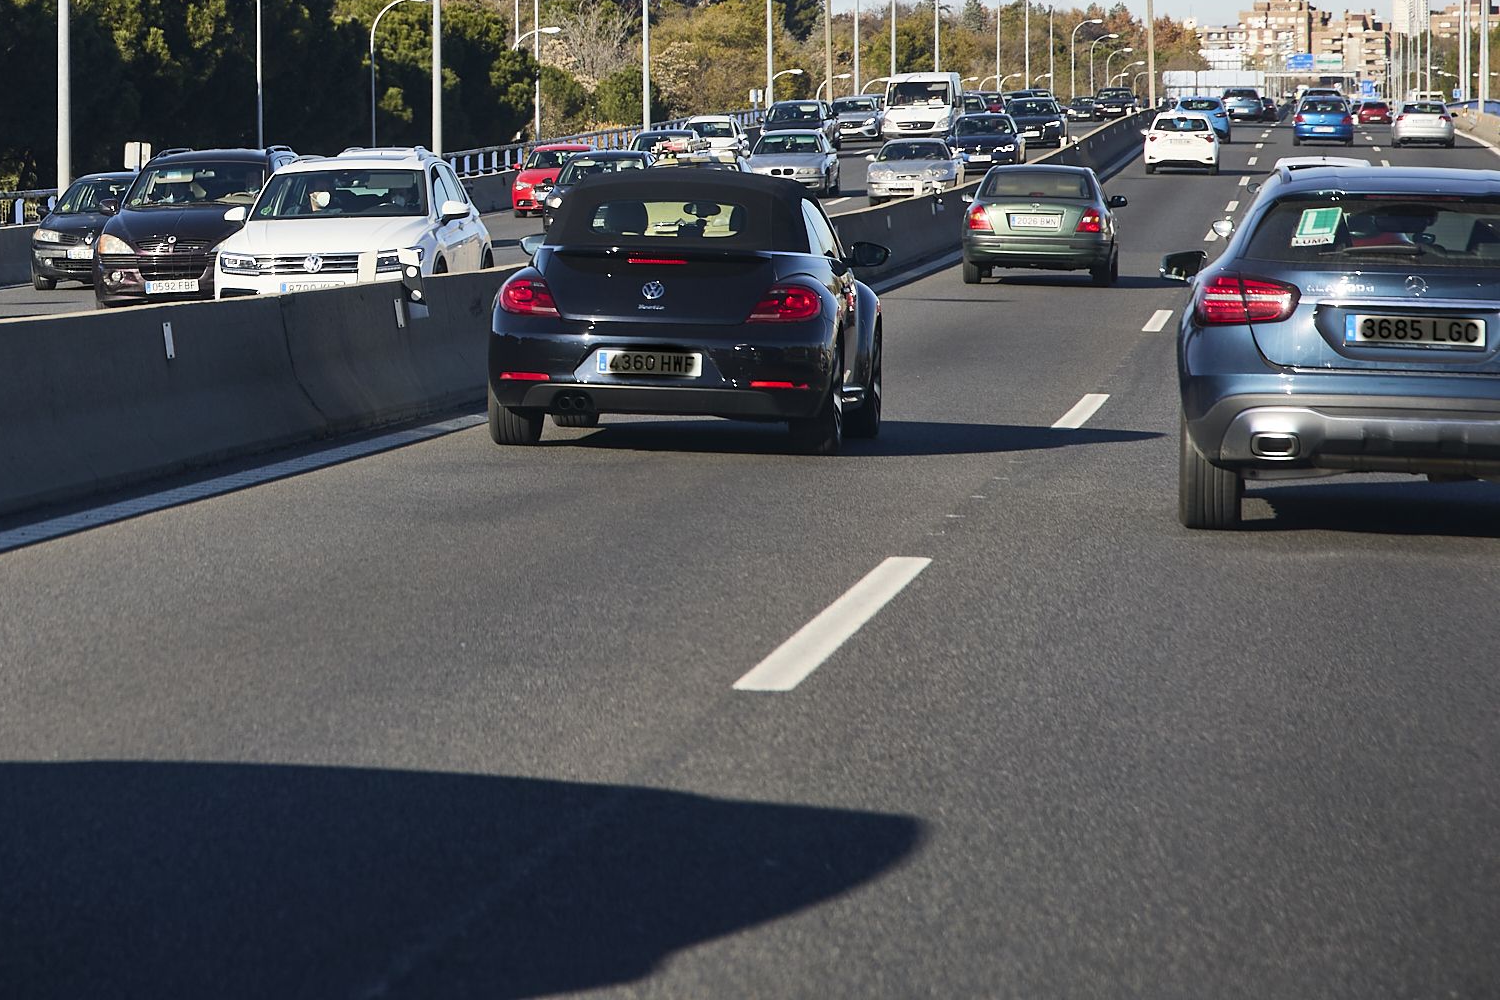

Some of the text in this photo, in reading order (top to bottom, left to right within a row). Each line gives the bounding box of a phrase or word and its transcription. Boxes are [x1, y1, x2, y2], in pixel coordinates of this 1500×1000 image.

[1017, 217, 1038, 225] 2026
[1302, 211, 1331, 235] L
[151, 280, 196, 292] 0592 FBF
[1361, 318, 1479, 343] 3685 LGC
[609, 354, 695, 373] 4360 HWF
